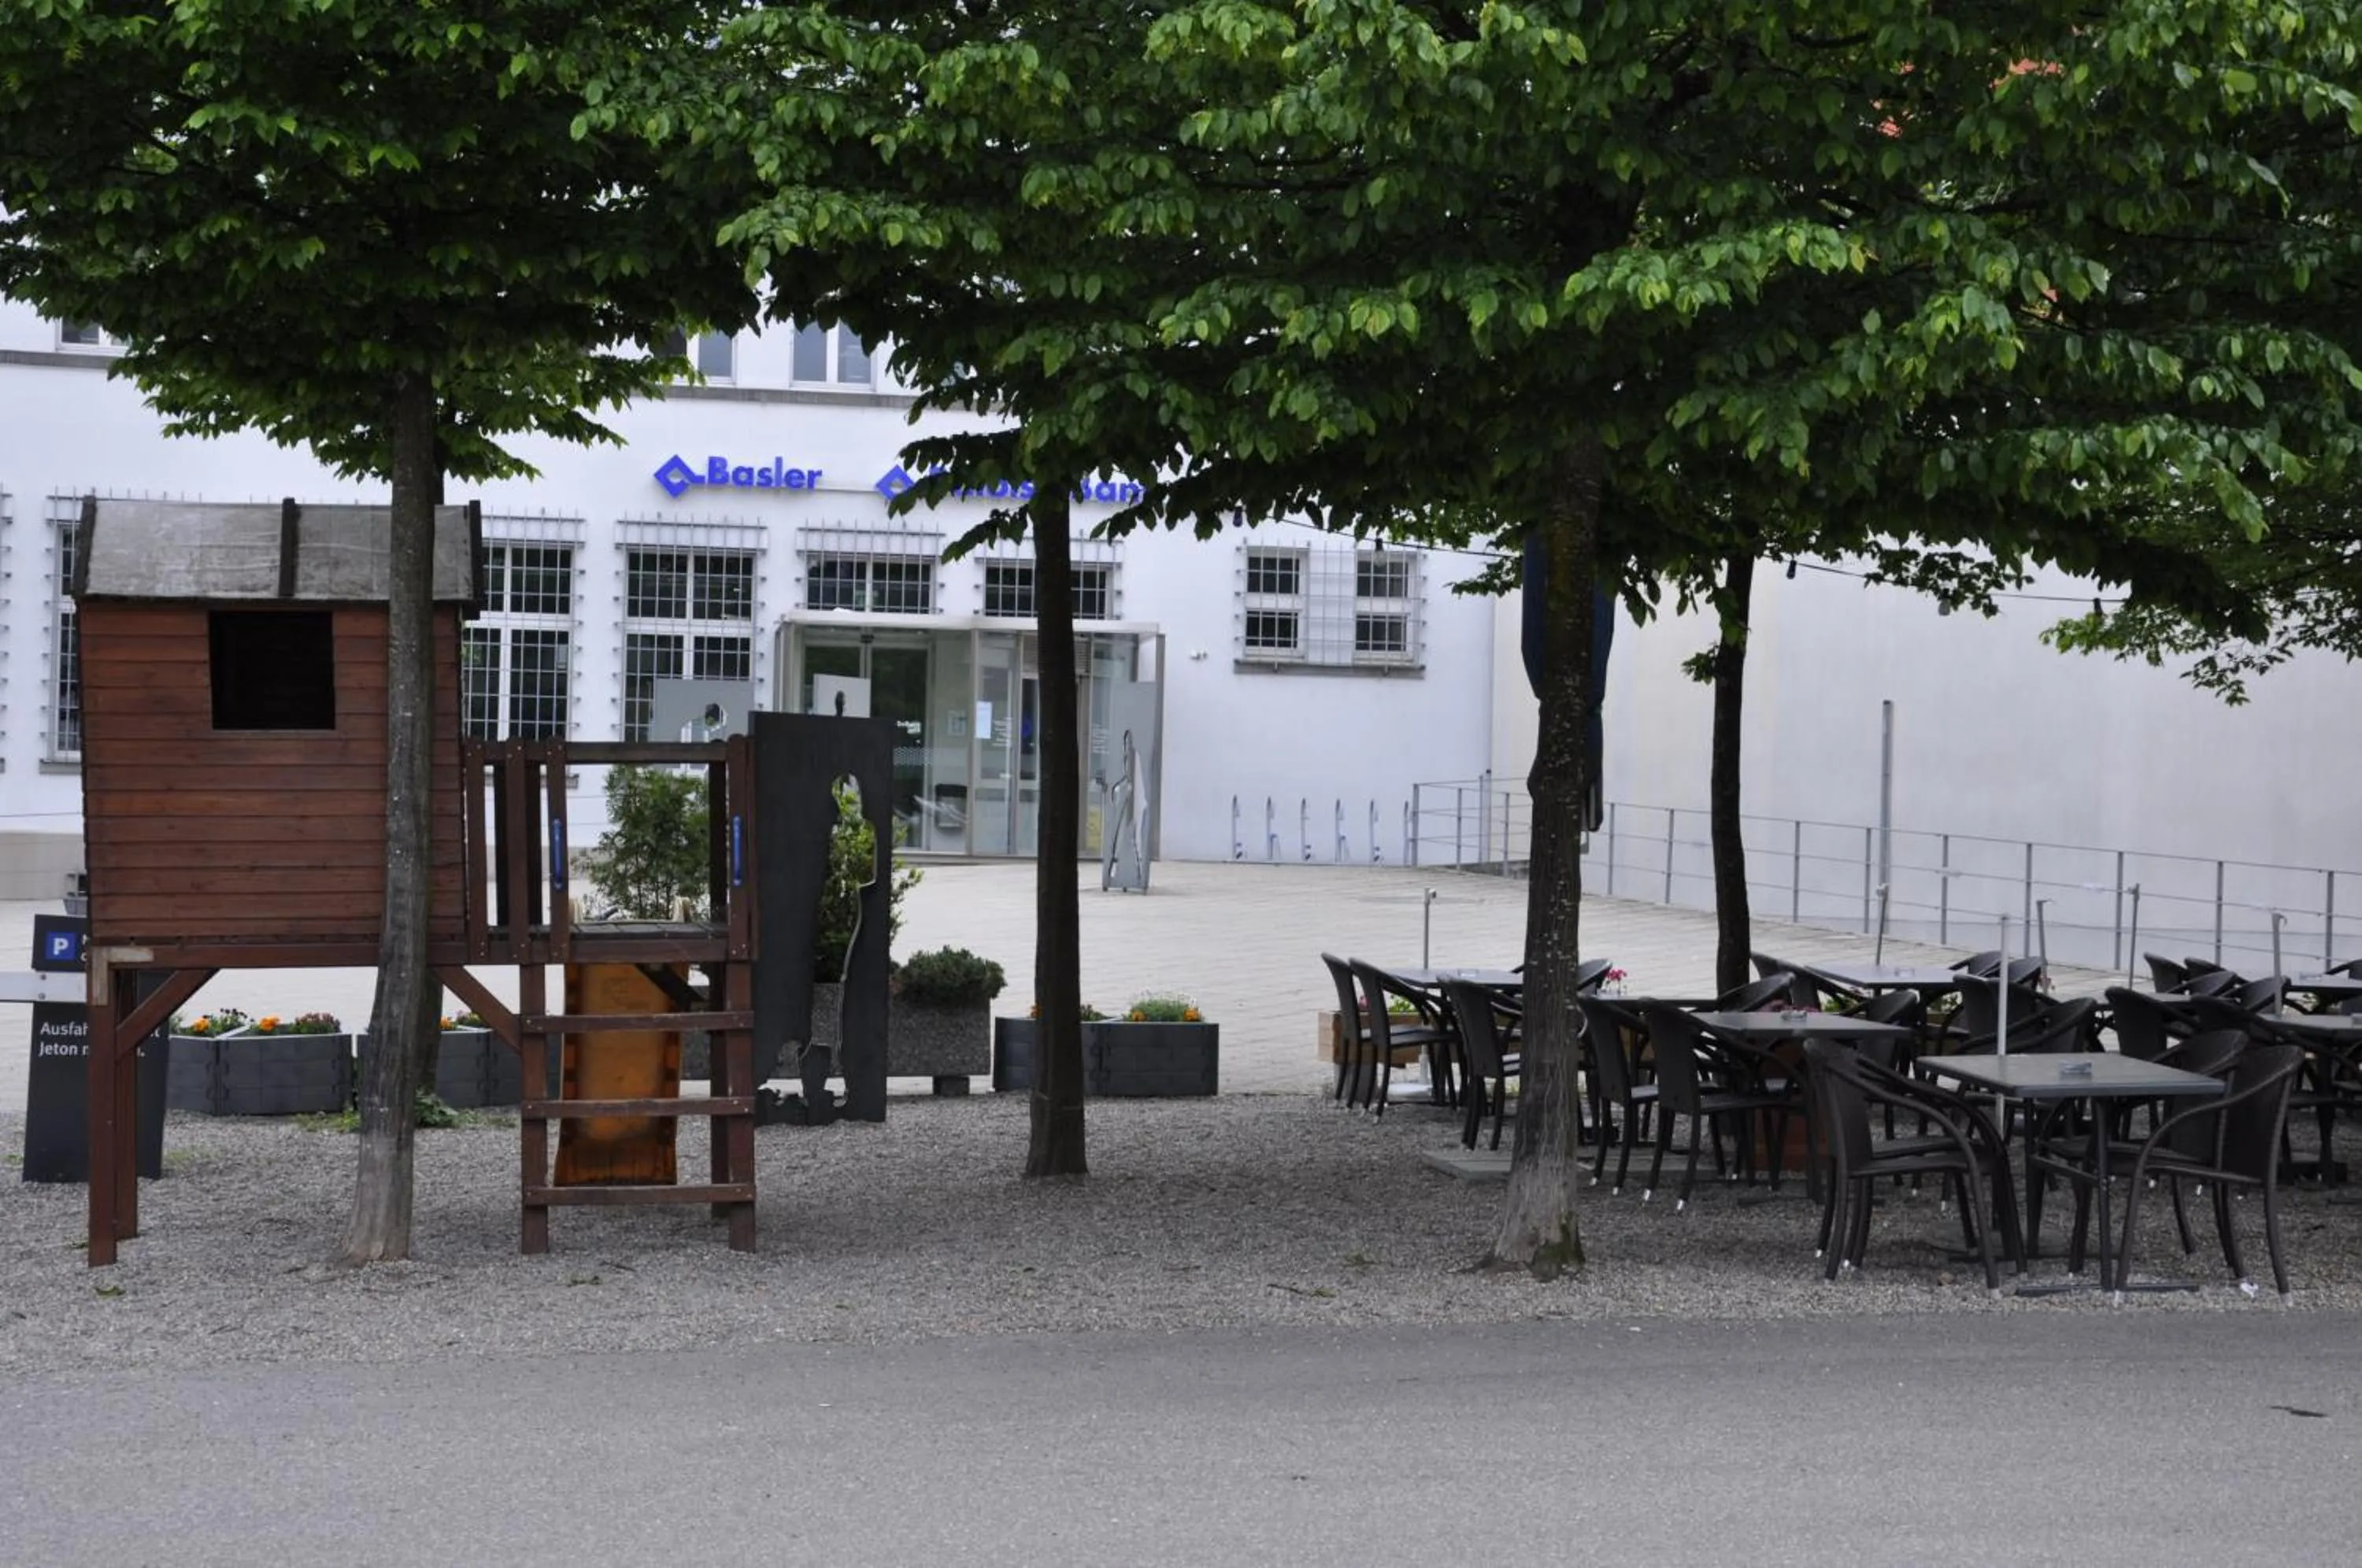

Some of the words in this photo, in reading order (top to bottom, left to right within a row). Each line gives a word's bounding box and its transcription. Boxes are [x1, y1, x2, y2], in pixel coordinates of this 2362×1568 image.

[708, 456, 823, 490] Basler
[53, 937, 69, 956] P
[38, 1041, 79, 1057] Jeton
